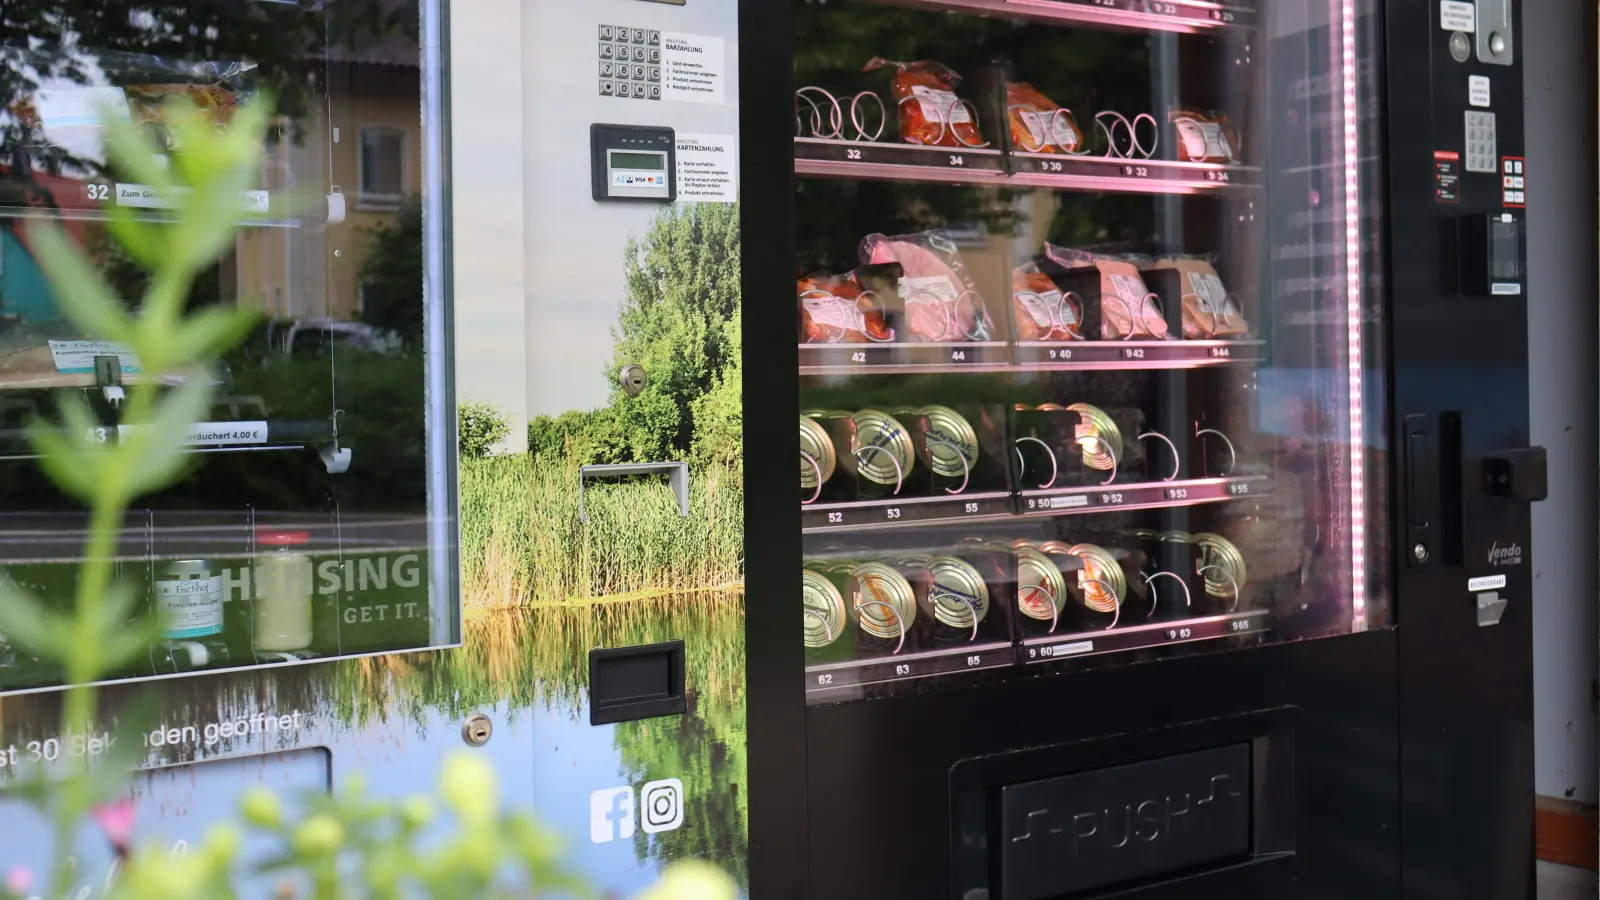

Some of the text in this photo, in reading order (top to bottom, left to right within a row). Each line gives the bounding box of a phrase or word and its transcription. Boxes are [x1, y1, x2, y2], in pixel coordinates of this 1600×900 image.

[621, 30, 627, 38] 2
[637, 31, 643, 40] 3
[653, 33, 659, 41] A
[621, 48, 627, 56] 5
[666, 44, 702, 54] BARZAHLUNG
[847, 150, 963, 166] 32 34
[1042, 162, 1062, 172] 9 30
[1126, 166, 1148, 177] 9 32
[1209, 171, 1228, 181] 9 34
[87, 184, 108, 200] 32
[121, 190, 140, 198] Zum
[852, 351, 965, 362] 42 44
[1050, 350, 1072, 358] 9 40
[86, 428, 106, 443] 43
[232, 431, 250, 440] 4,00
[252, 430, 258, 439] €
[1029, 499, 1035, 508] 9
[1038, 498, 1050, 508] 50
[1102, 494, 1122, 503] 9 52
[828, 503, 978, 522] 52 53 55
[1488, 540, 1521, 563] Vendo
[344, 602, 420, 624] GET IT.
[1170, 628, 1191, 639] 9 63
[1030, 649, 1036, 658] 9
[1040, 647, 1052, 656] 60
[819, 656, 980, 684] 62 63 65
[26, 738, 59, 762] 30
[204, 710, 300, 744] geöffnet
[1074, 793, 1190, 856] PUSH
